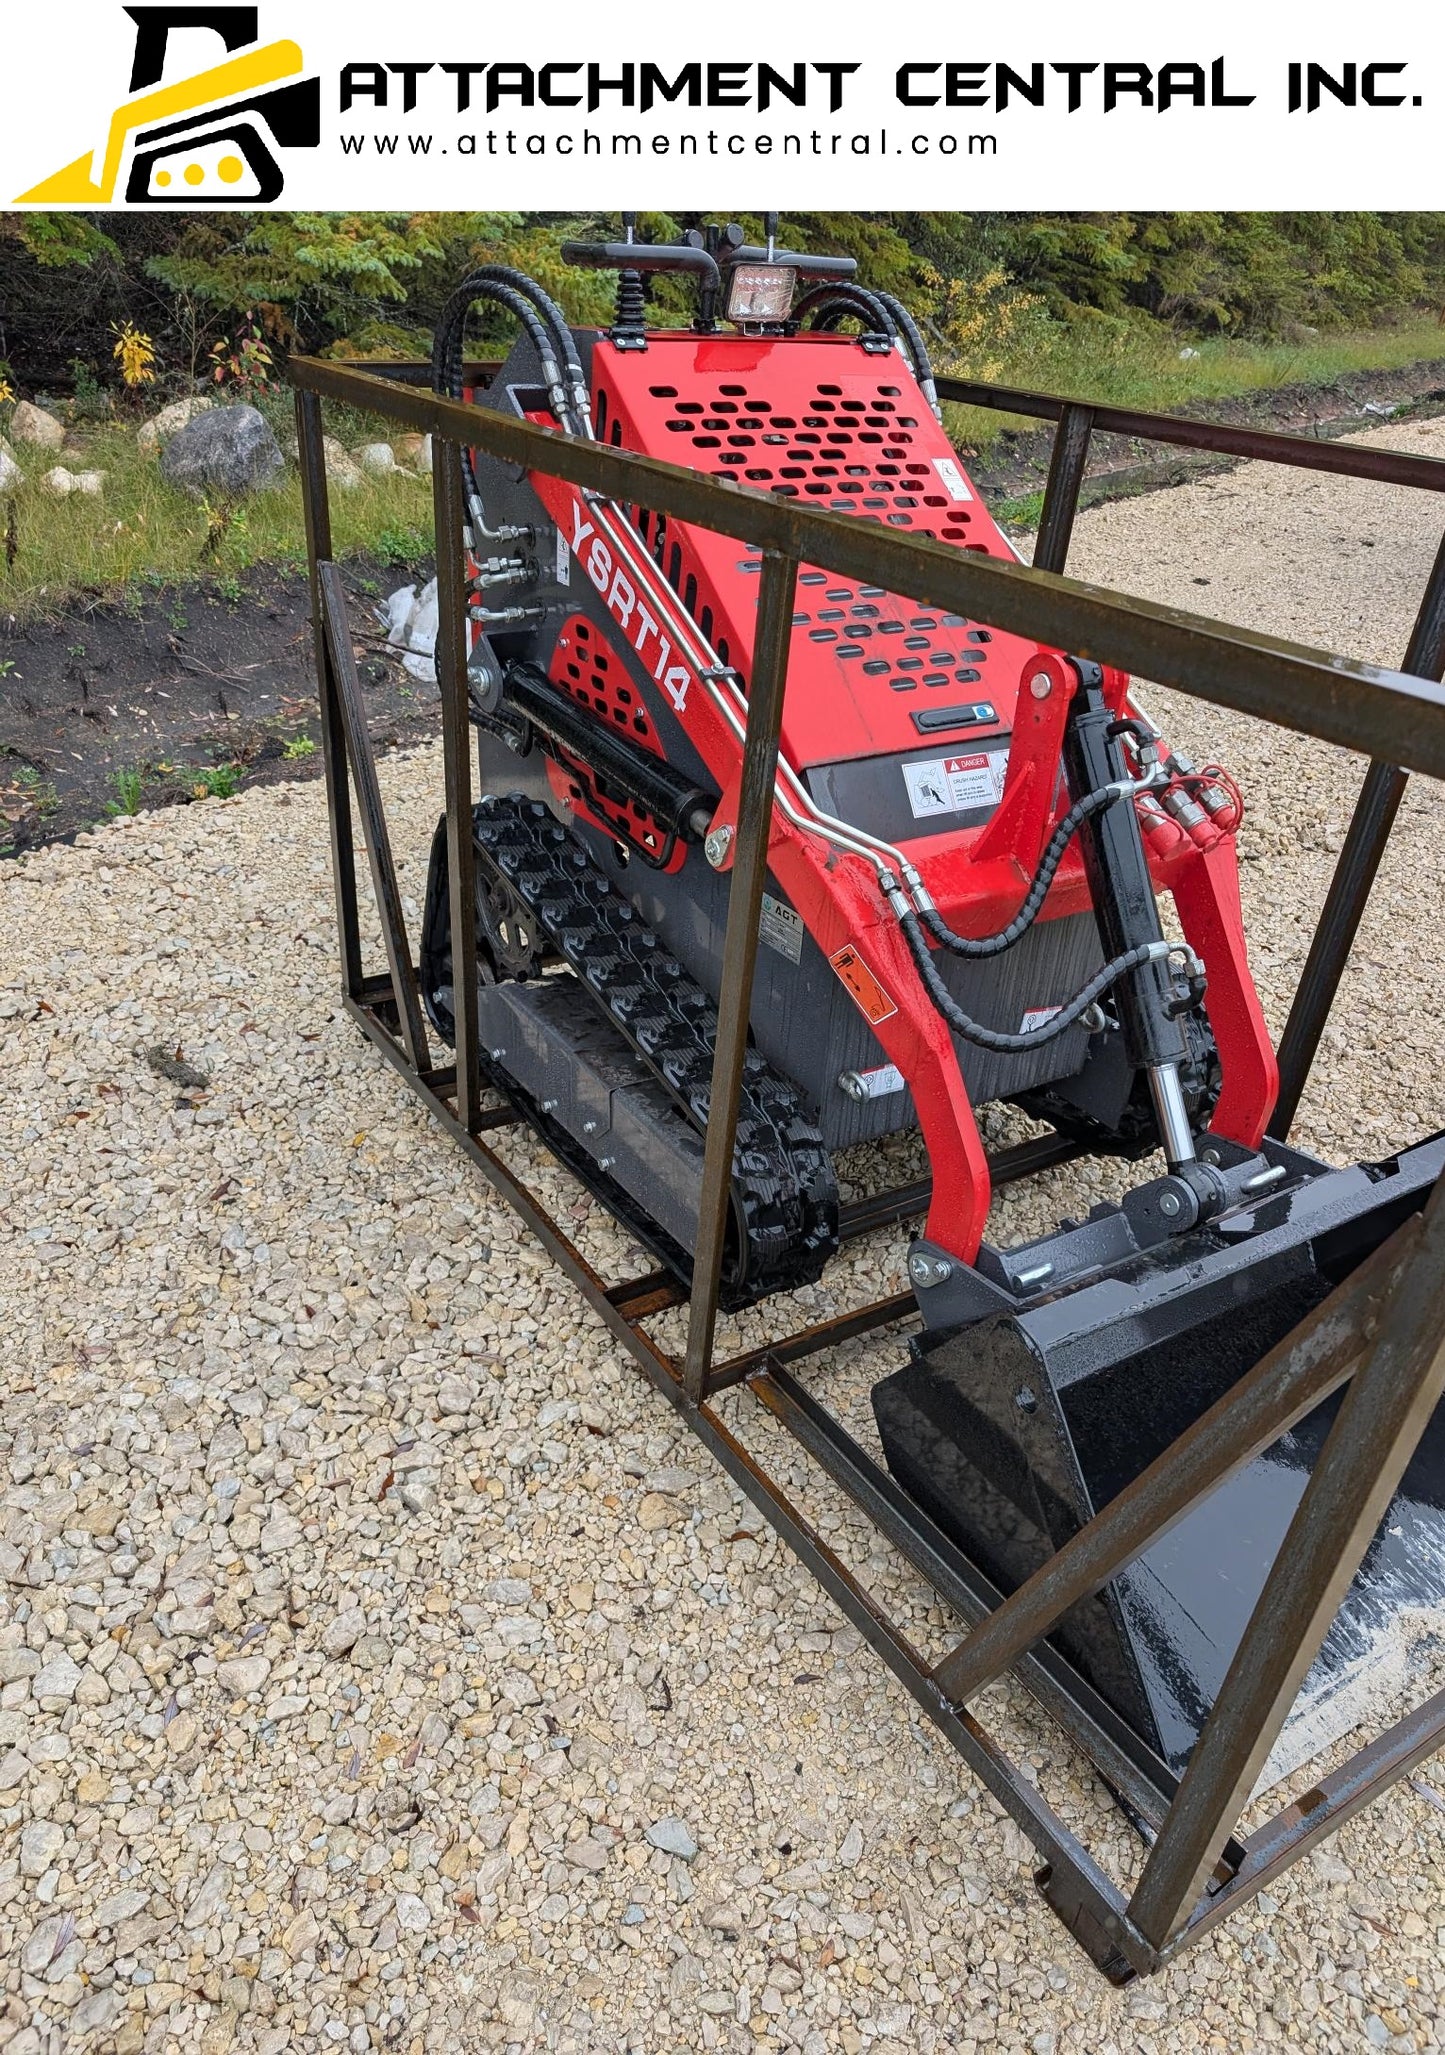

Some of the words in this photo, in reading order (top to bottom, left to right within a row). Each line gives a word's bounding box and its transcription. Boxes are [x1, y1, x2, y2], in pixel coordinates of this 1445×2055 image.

[571, 497, 691, 713] YSRT14
[960, 757, 986, 768] DANGER
[775, 905, 798, 925] AGT
